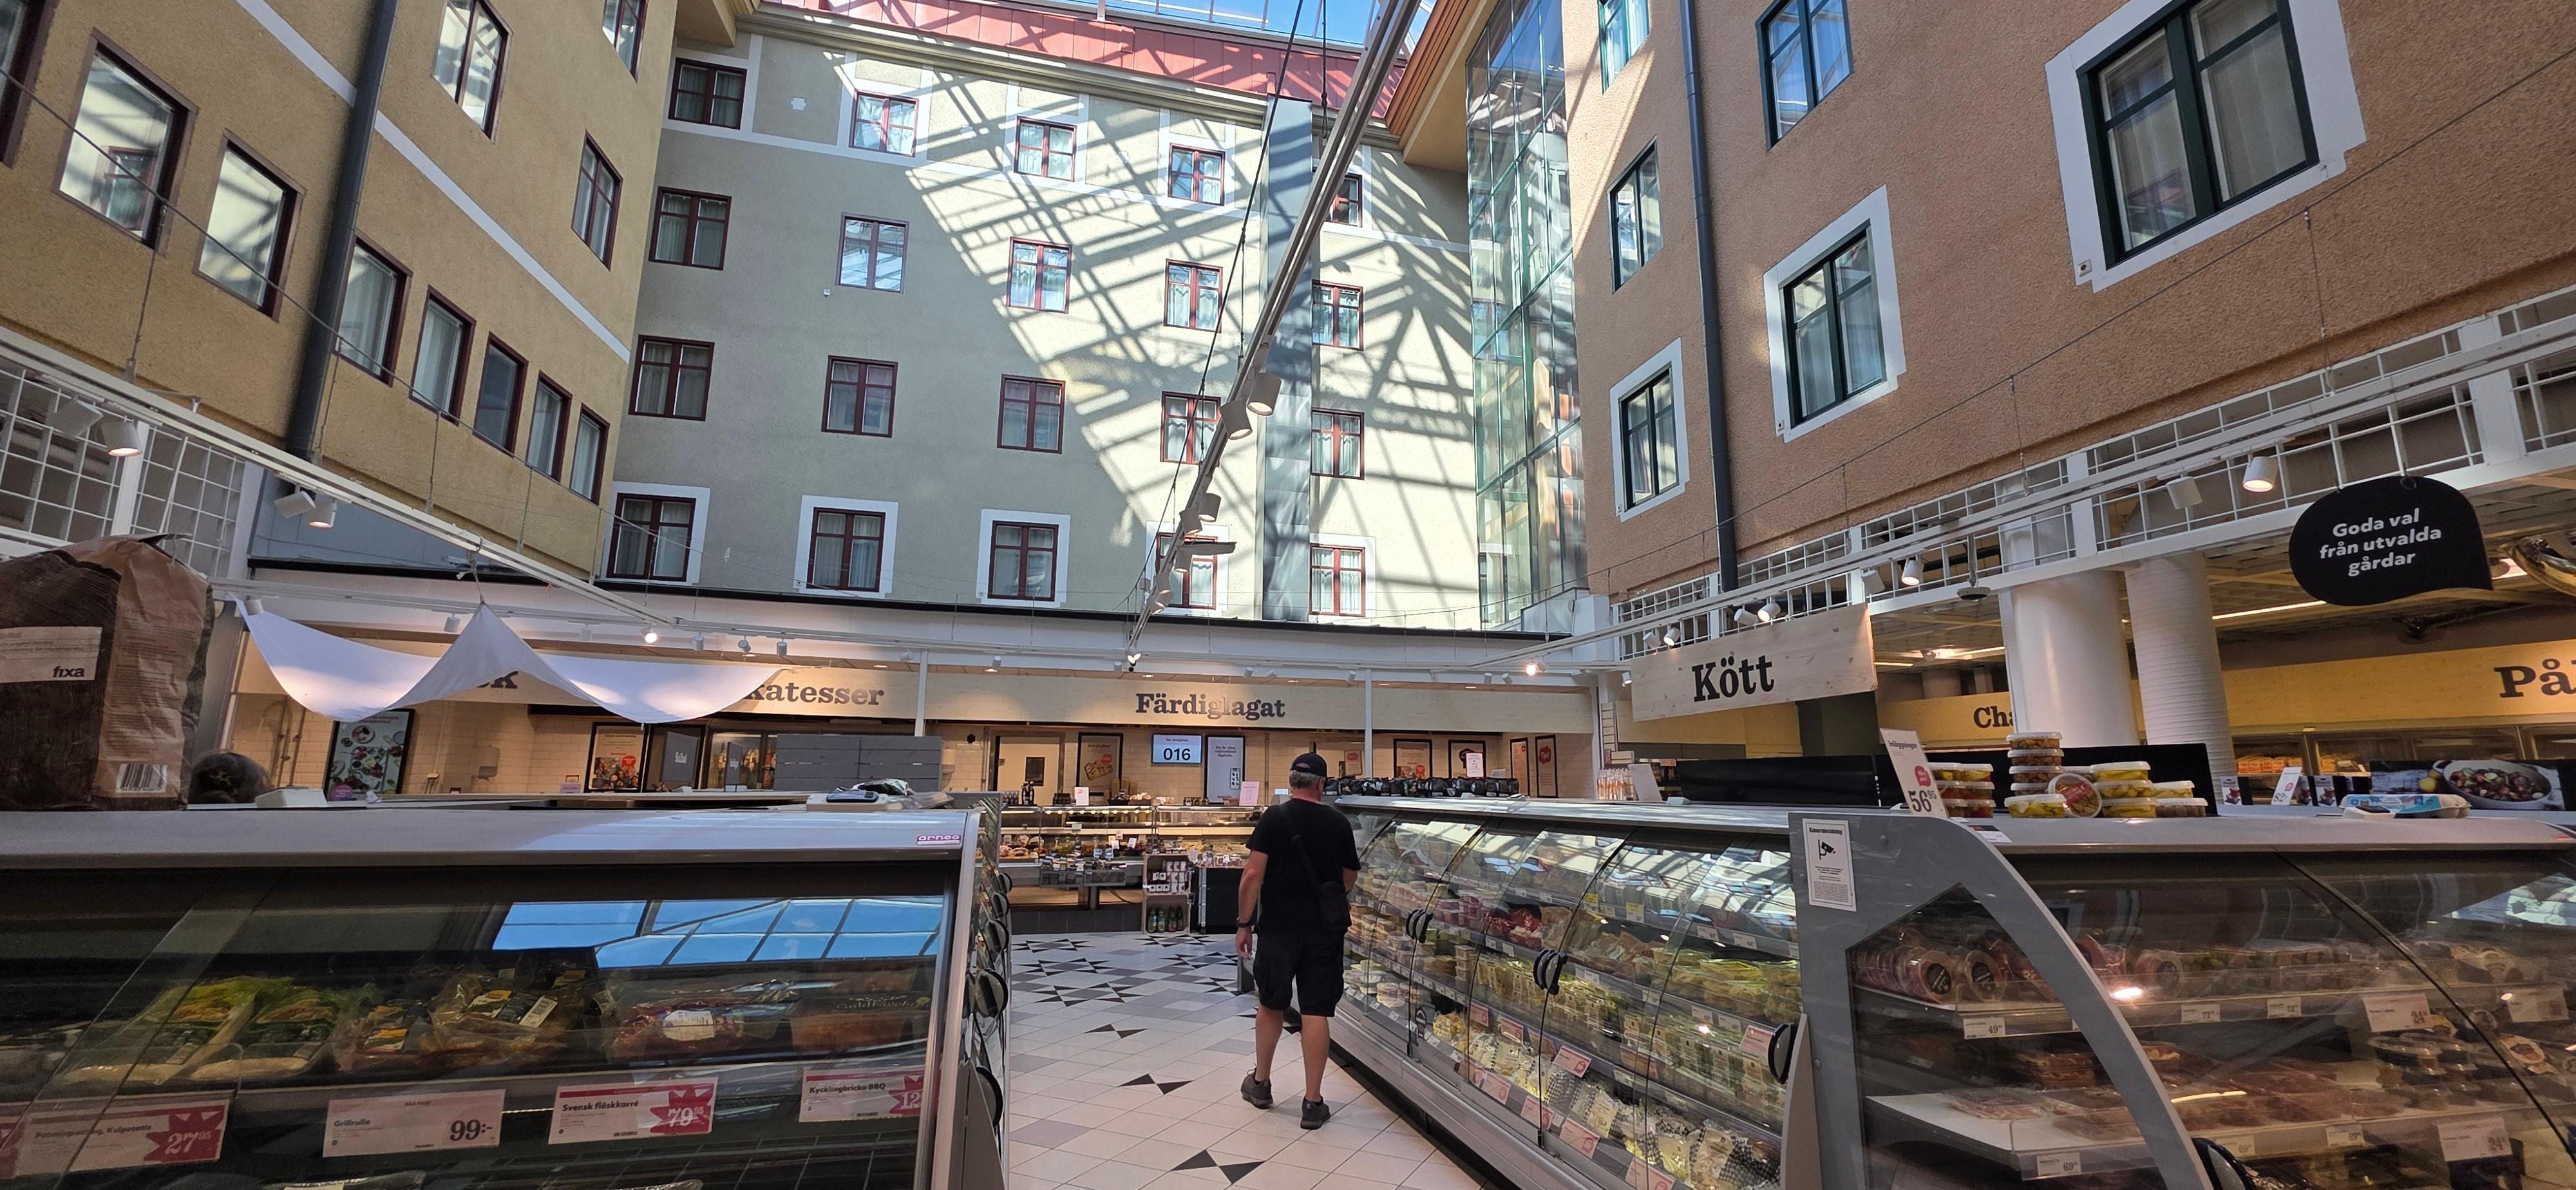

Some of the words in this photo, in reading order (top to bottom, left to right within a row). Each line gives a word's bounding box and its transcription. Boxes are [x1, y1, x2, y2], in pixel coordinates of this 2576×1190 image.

[2332, 516, 2385, 537] Goda
[2389, 507, 2420, 527] val
[2319, 541, 2359, 559] från
[2363, 526, 2442, 551] utvalda
[2347, 552, 2416, 577] gårdar
[52, 666, 85, 677] fixa
[1691, 654, 1775, 703] Kött
[2493, 658, 2576, 698] På
[1135, 692, 1286, 721] Färdiglagat
[1163, 748, 1191, 760] 016
[1908, 789, 1932, 813] 56
[809, 1084, 867, 1095] Kycklingbricka
[562, 1103, 593, 1112] Svensk
[594, 1100, 639, 1110] fläskkarré
[667, 1107, 693, 1128] 79
[334, 1119, 371, 1128] Grillrulle
[450, 1119, 493, 1142] 99:-
[165, 1132, 198, 1155] 27
